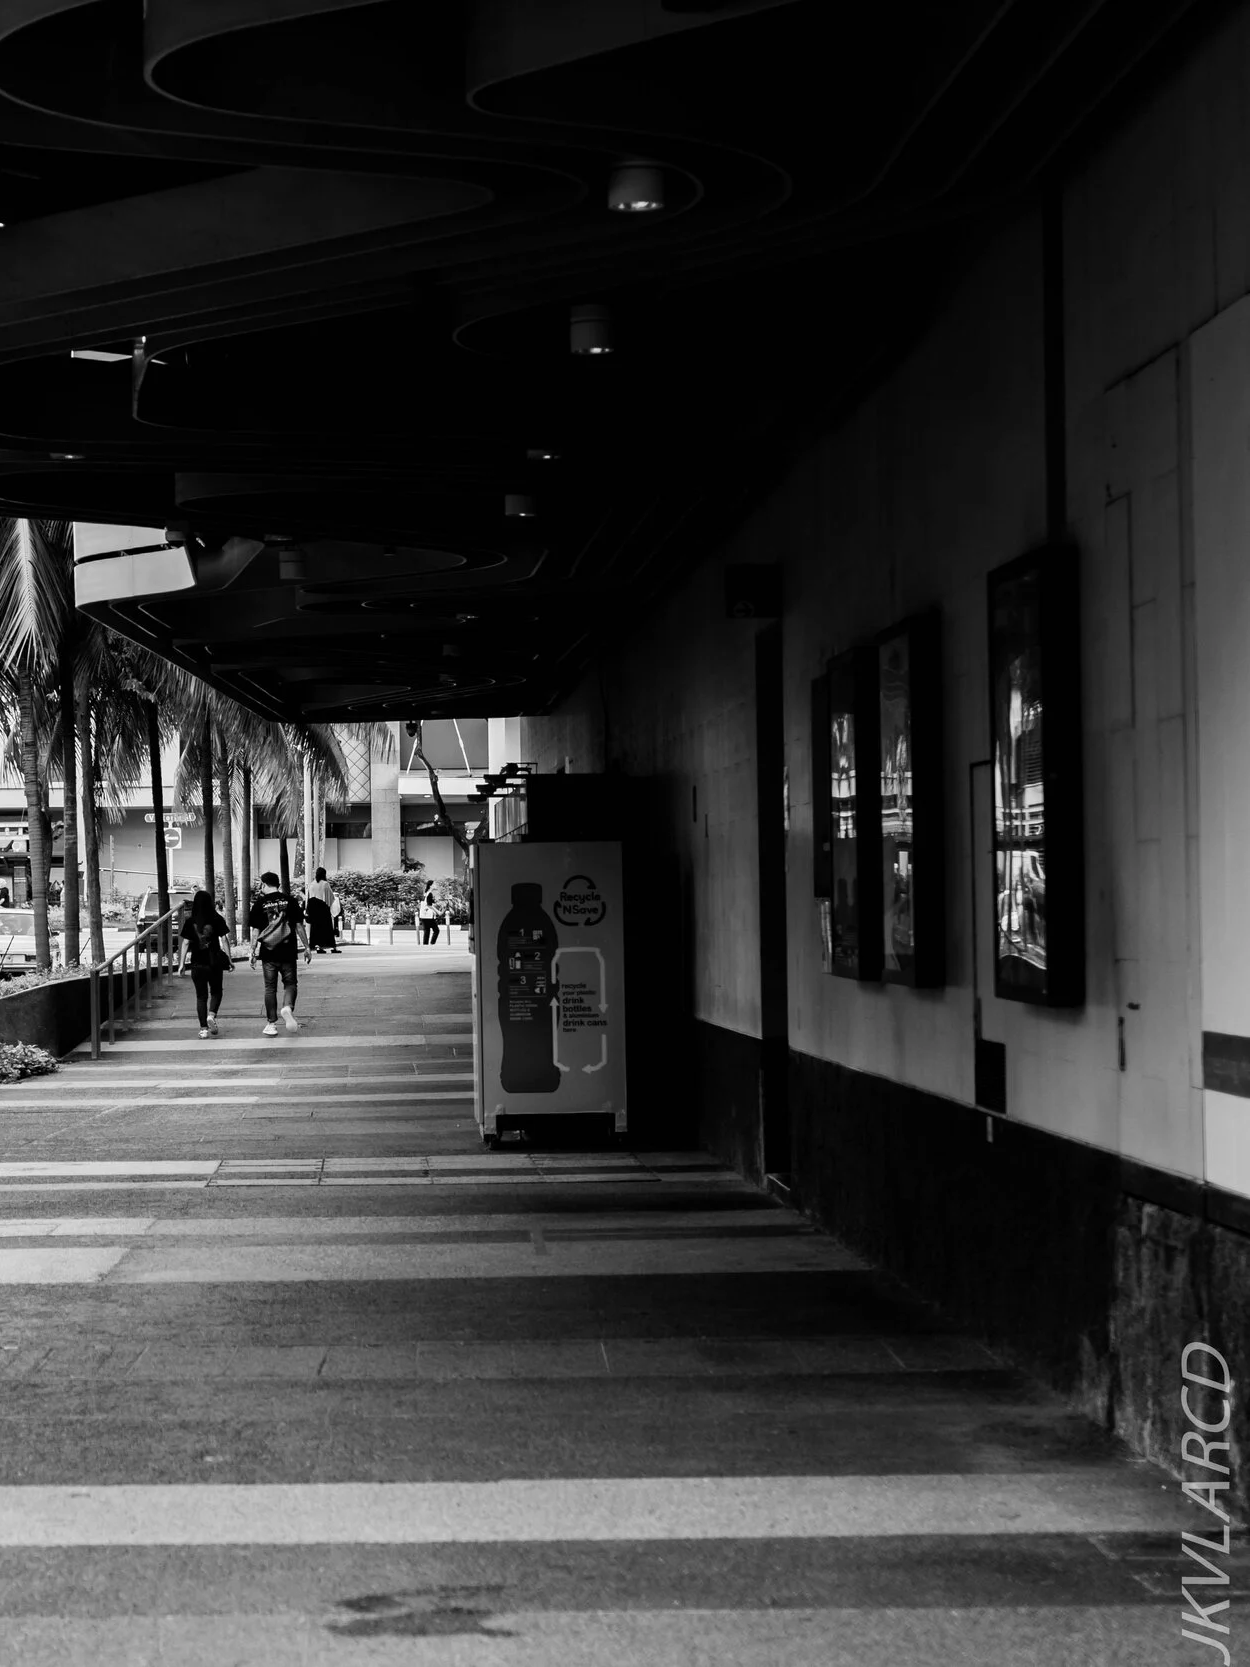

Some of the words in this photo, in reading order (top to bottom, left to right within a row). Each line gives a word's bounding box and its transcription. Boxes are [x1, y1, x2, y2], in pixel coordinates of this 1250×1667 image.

[560, 892, 601, 904] Recycle
[562, 996, 585, 1004] drink
[562, 1005, 592, 1013] bottles
[562, 1018, 586, 1027] drink
